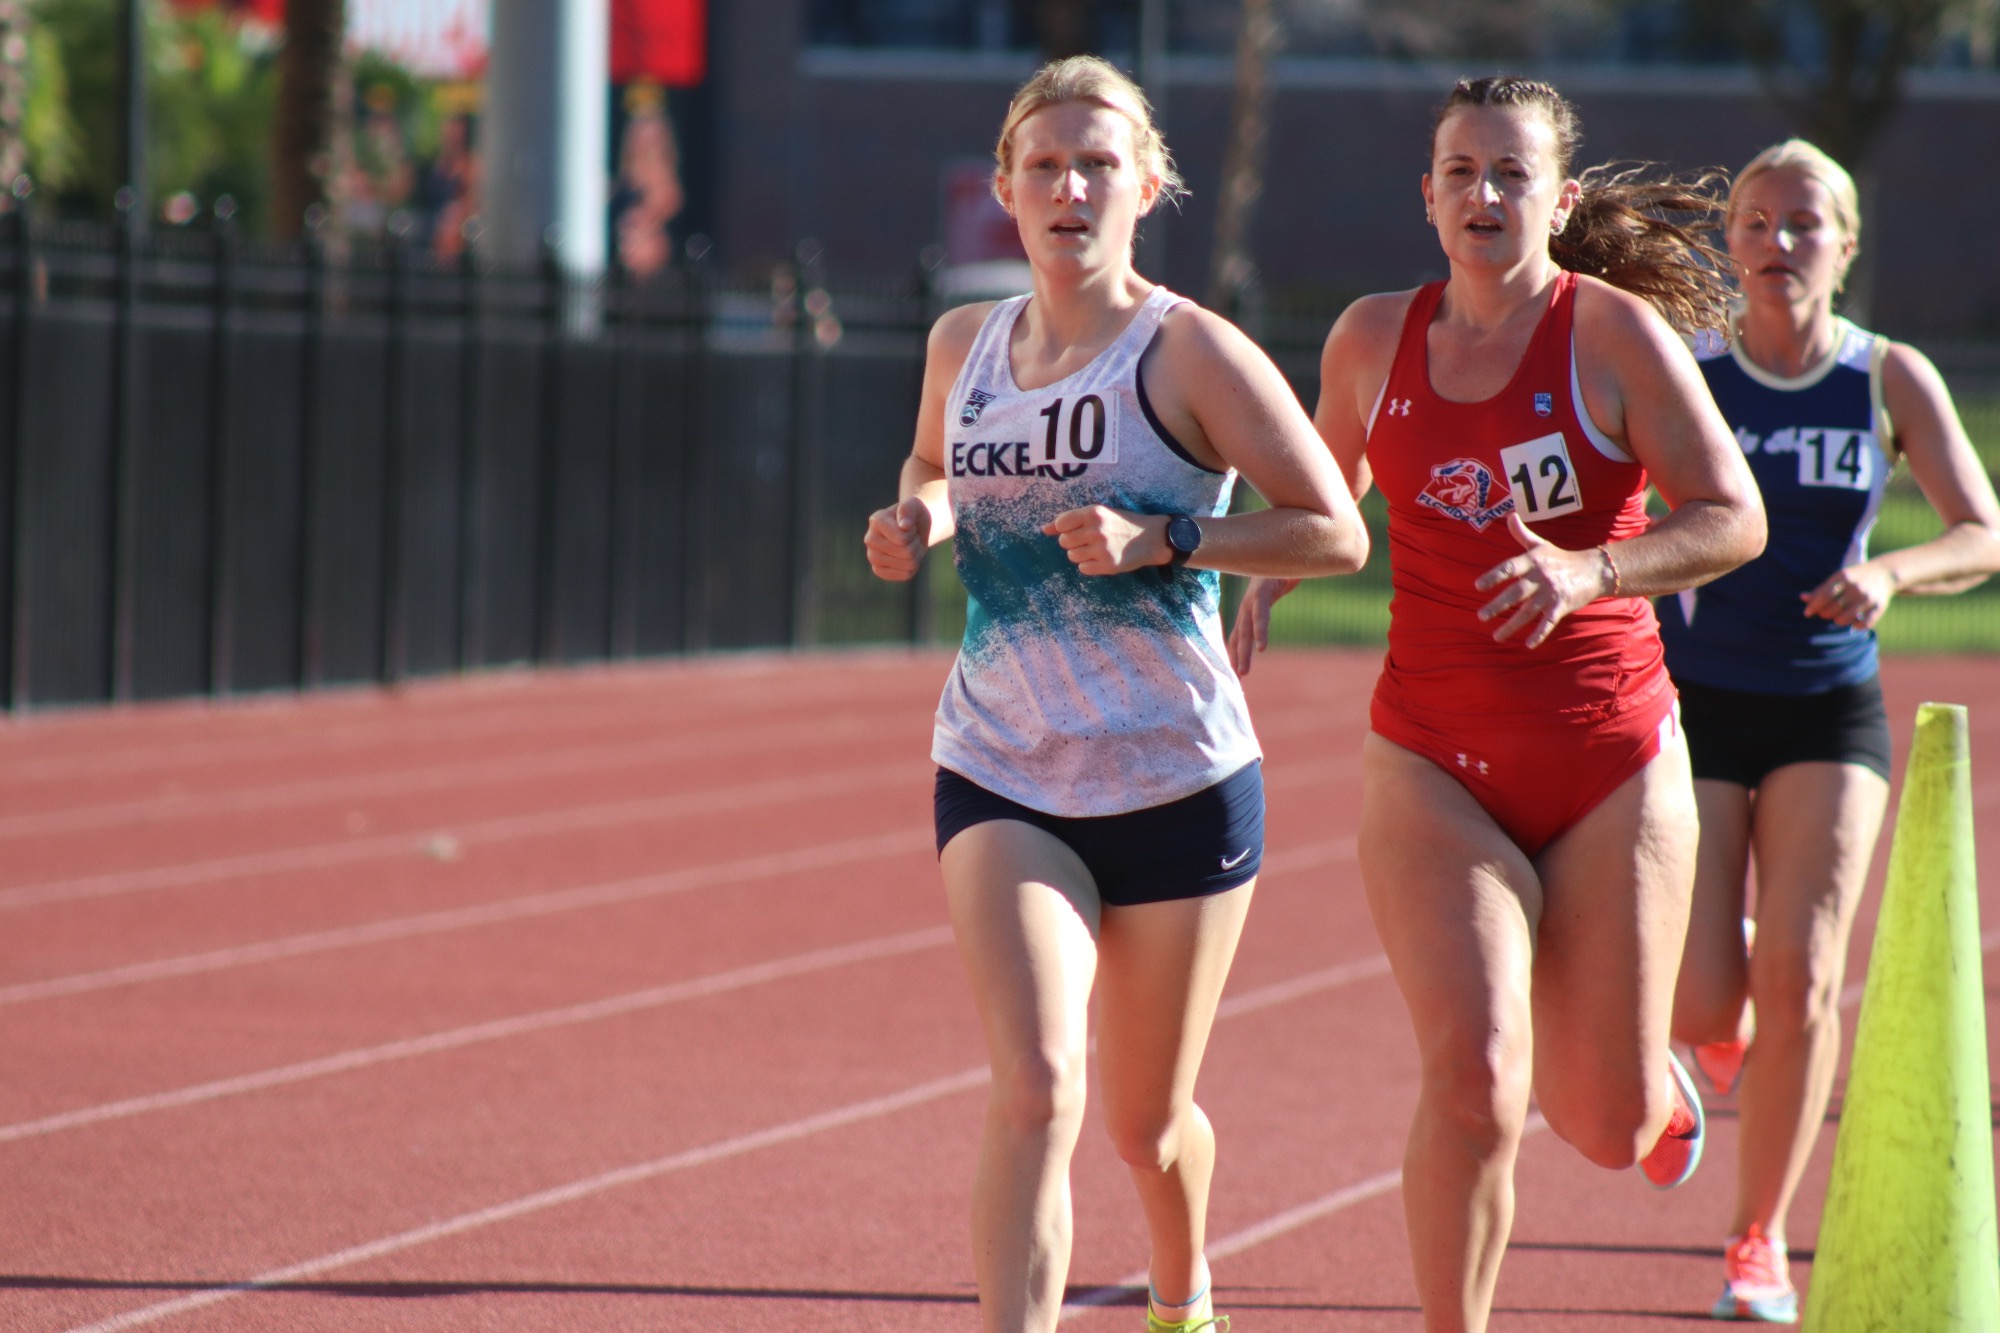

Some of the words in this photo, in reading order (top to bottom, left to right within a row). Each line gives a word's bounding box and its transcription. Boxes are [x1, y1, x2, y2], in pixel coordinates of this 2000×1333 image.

[1040, 394, 1106, 460] 10
[1511, 455, 1575, 513] 12
[1806, 433, 1862, 483] 14
